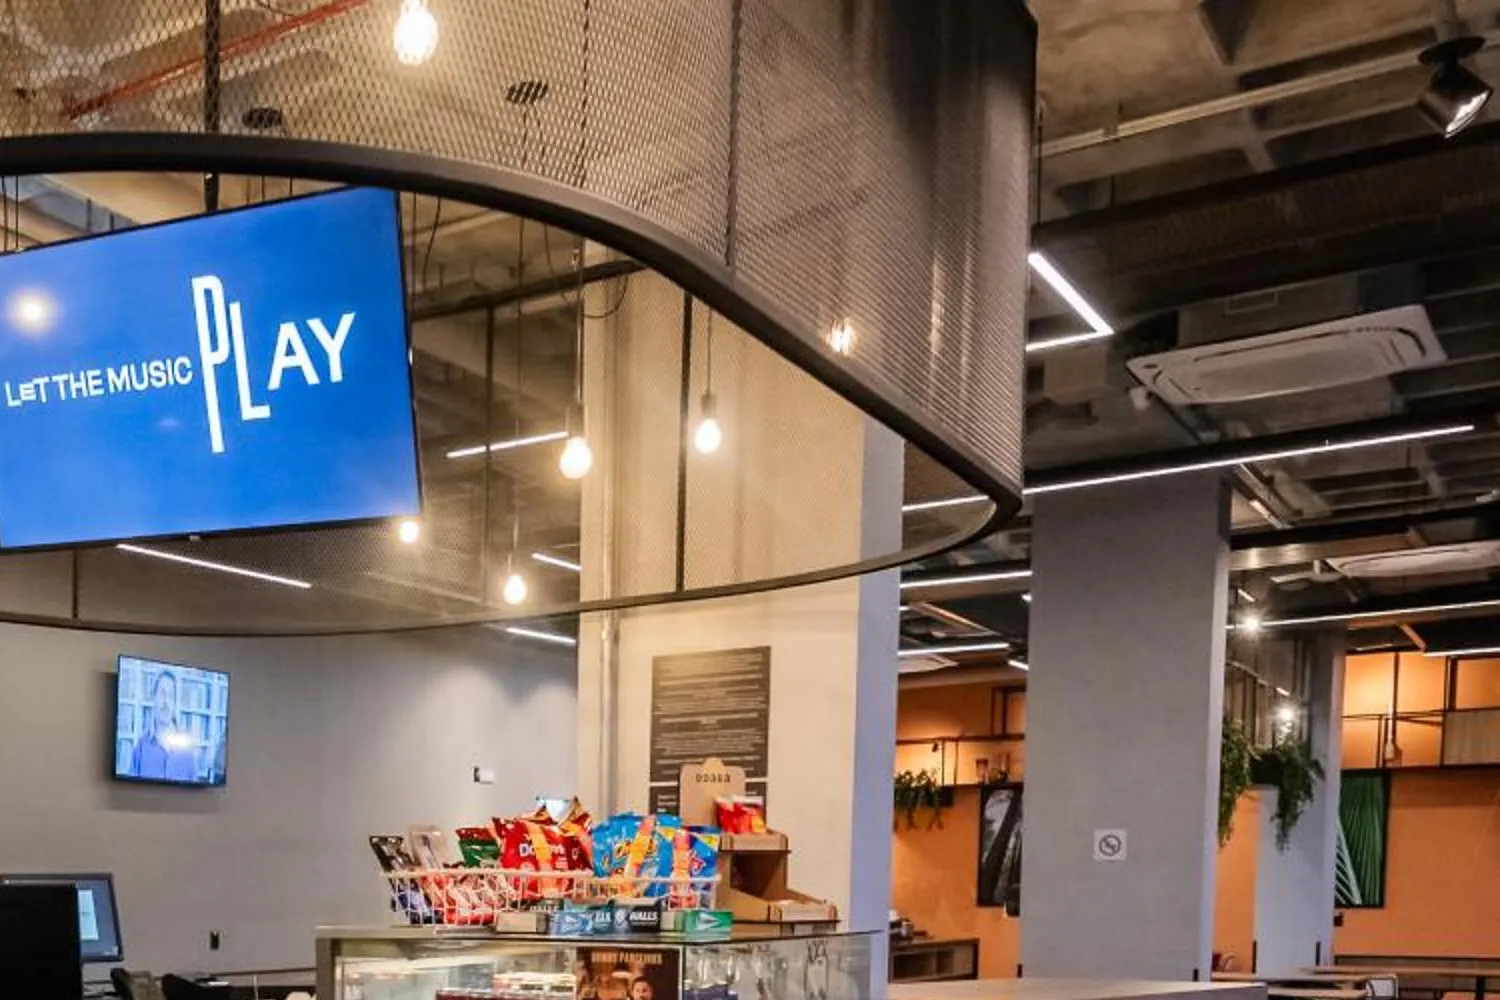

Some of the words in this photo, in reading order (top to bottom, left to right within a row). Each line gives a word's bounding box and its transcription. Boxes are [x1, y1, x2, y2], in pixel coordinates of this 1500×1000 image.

[5, 377, 49, 407] LET
[51, 369, 105, 401] THE
[107, 356, 194, 394] MUSIC
[192, 275, 357, 454] PLAY
